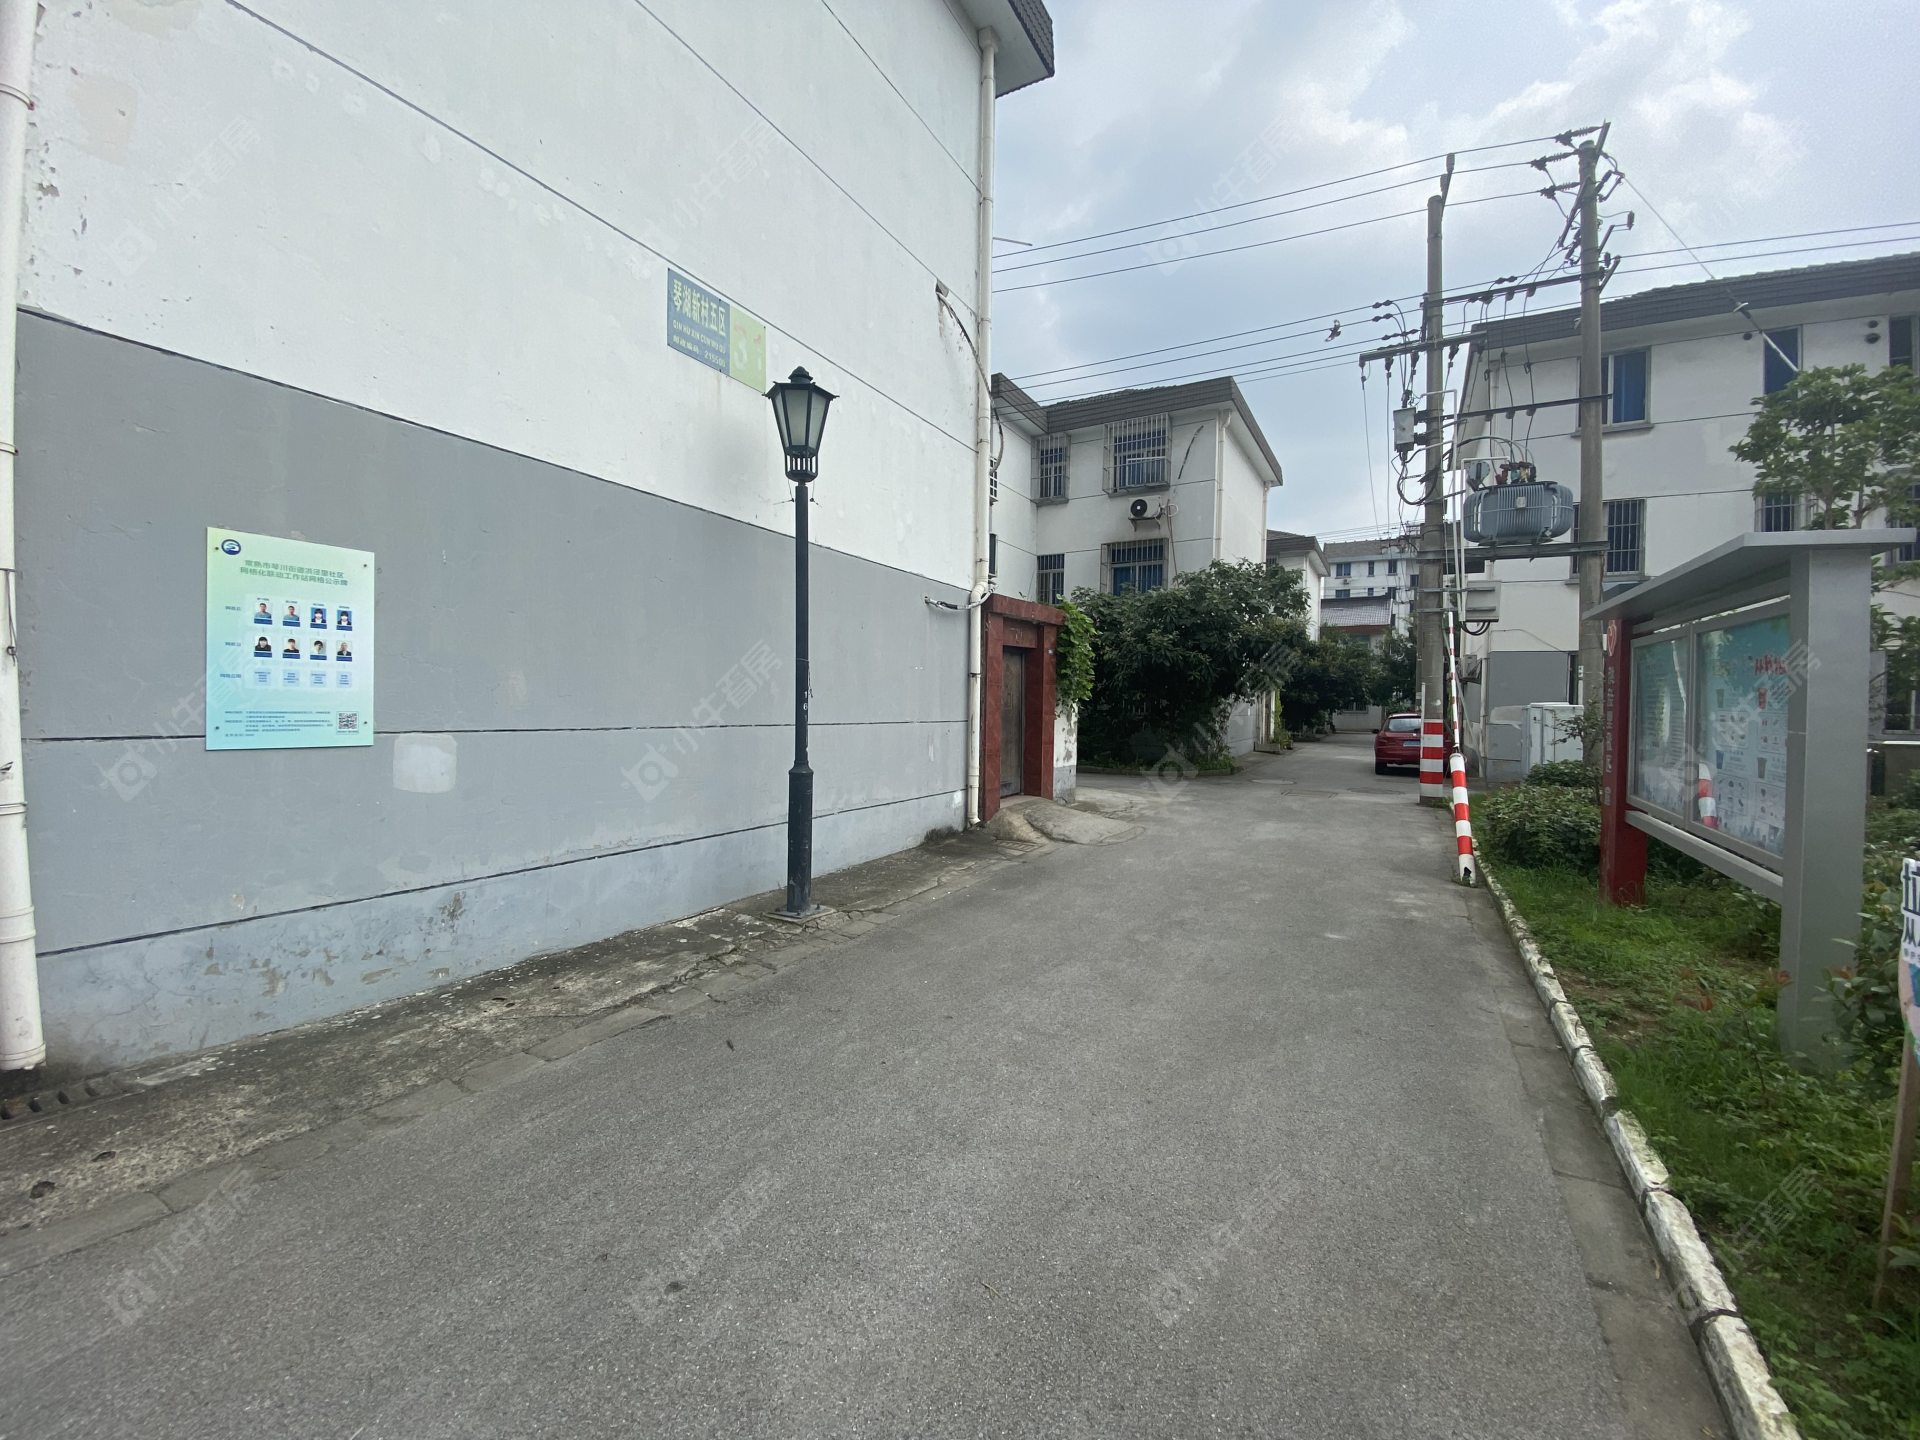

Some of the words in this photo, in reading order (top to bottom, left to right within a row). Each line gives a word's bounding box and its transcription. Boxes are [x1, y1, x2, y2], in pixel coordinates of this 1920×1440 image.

[673, 279, 727, 337] 琴湖新村五区
